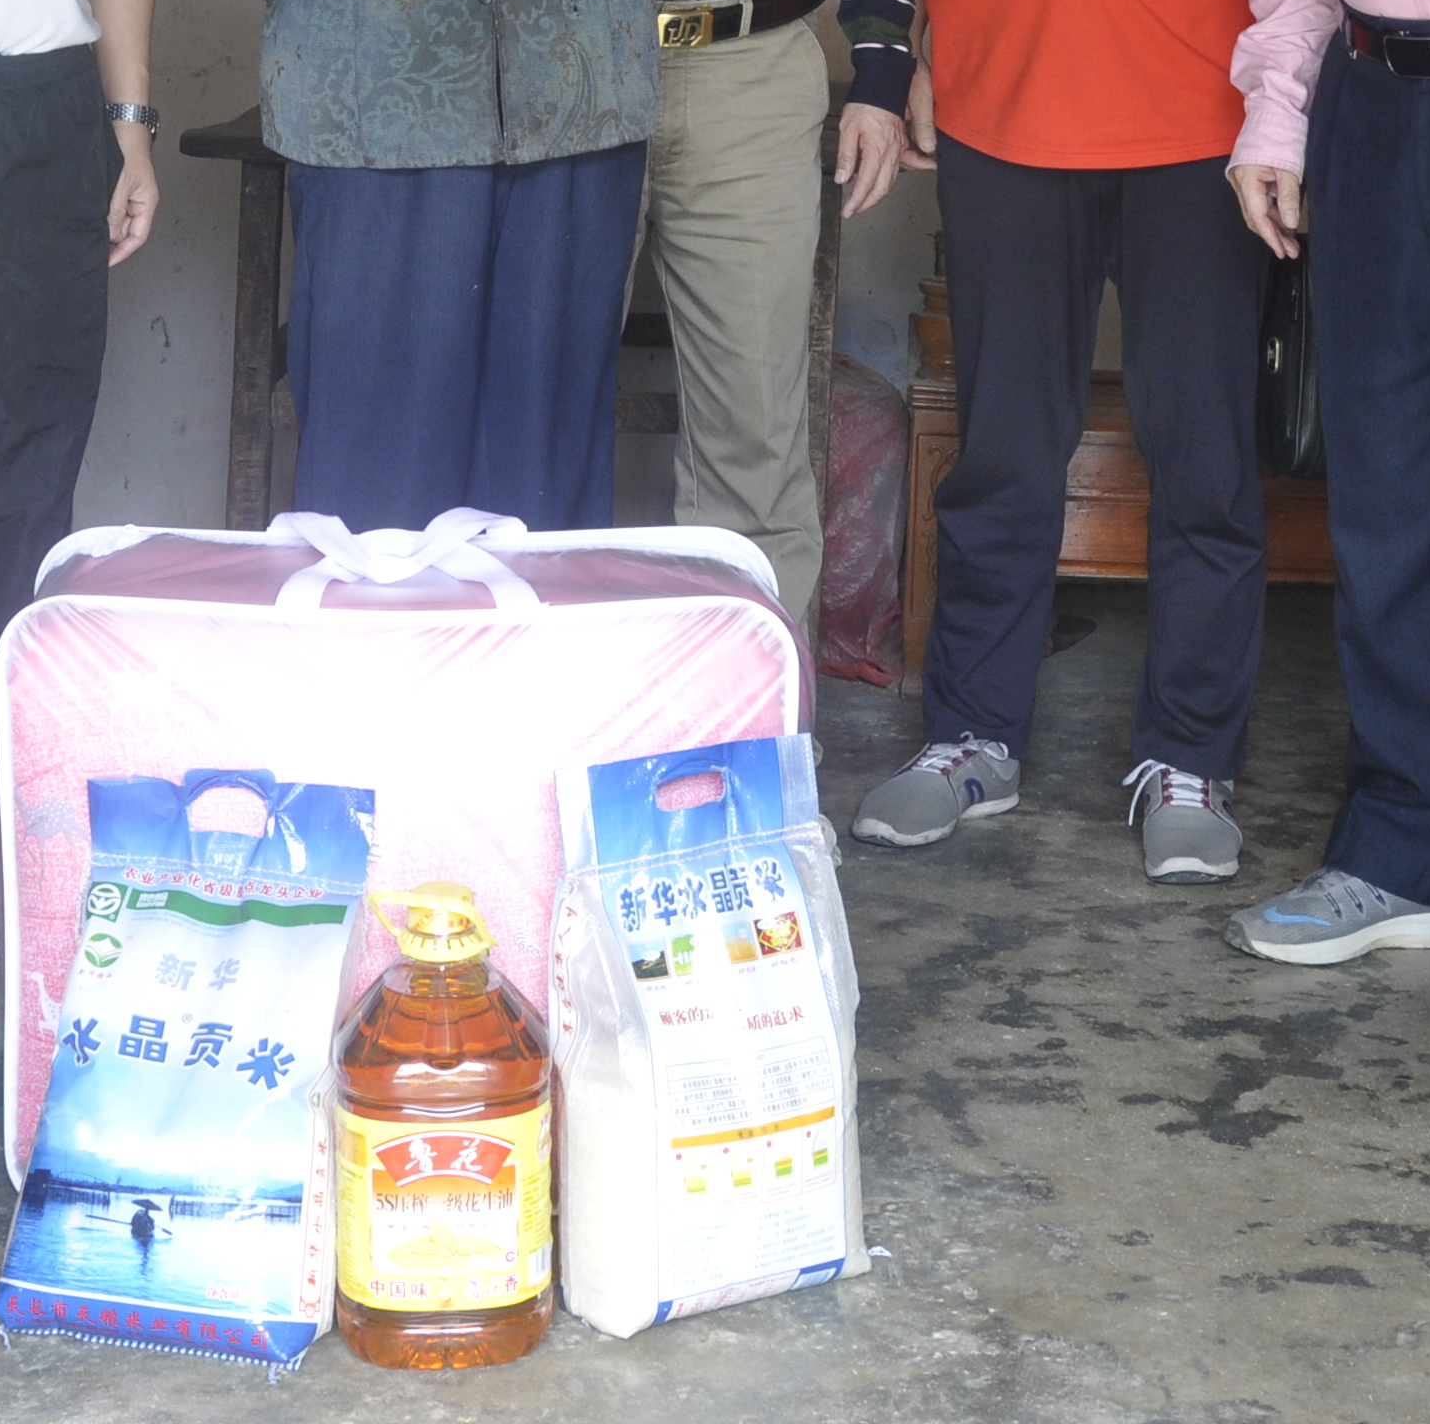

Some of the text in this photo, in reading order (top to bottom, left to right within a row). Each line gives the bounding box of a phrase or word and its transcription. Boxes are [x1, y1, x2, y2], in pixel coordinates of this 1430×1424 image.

[153, 951, 243, 993] 新华
[60, 1012, 298, 1092] 水晶贡米
[403, 1137, 483, 1173] 鲁花
[370, 1278, 429, 1300] 中国味
